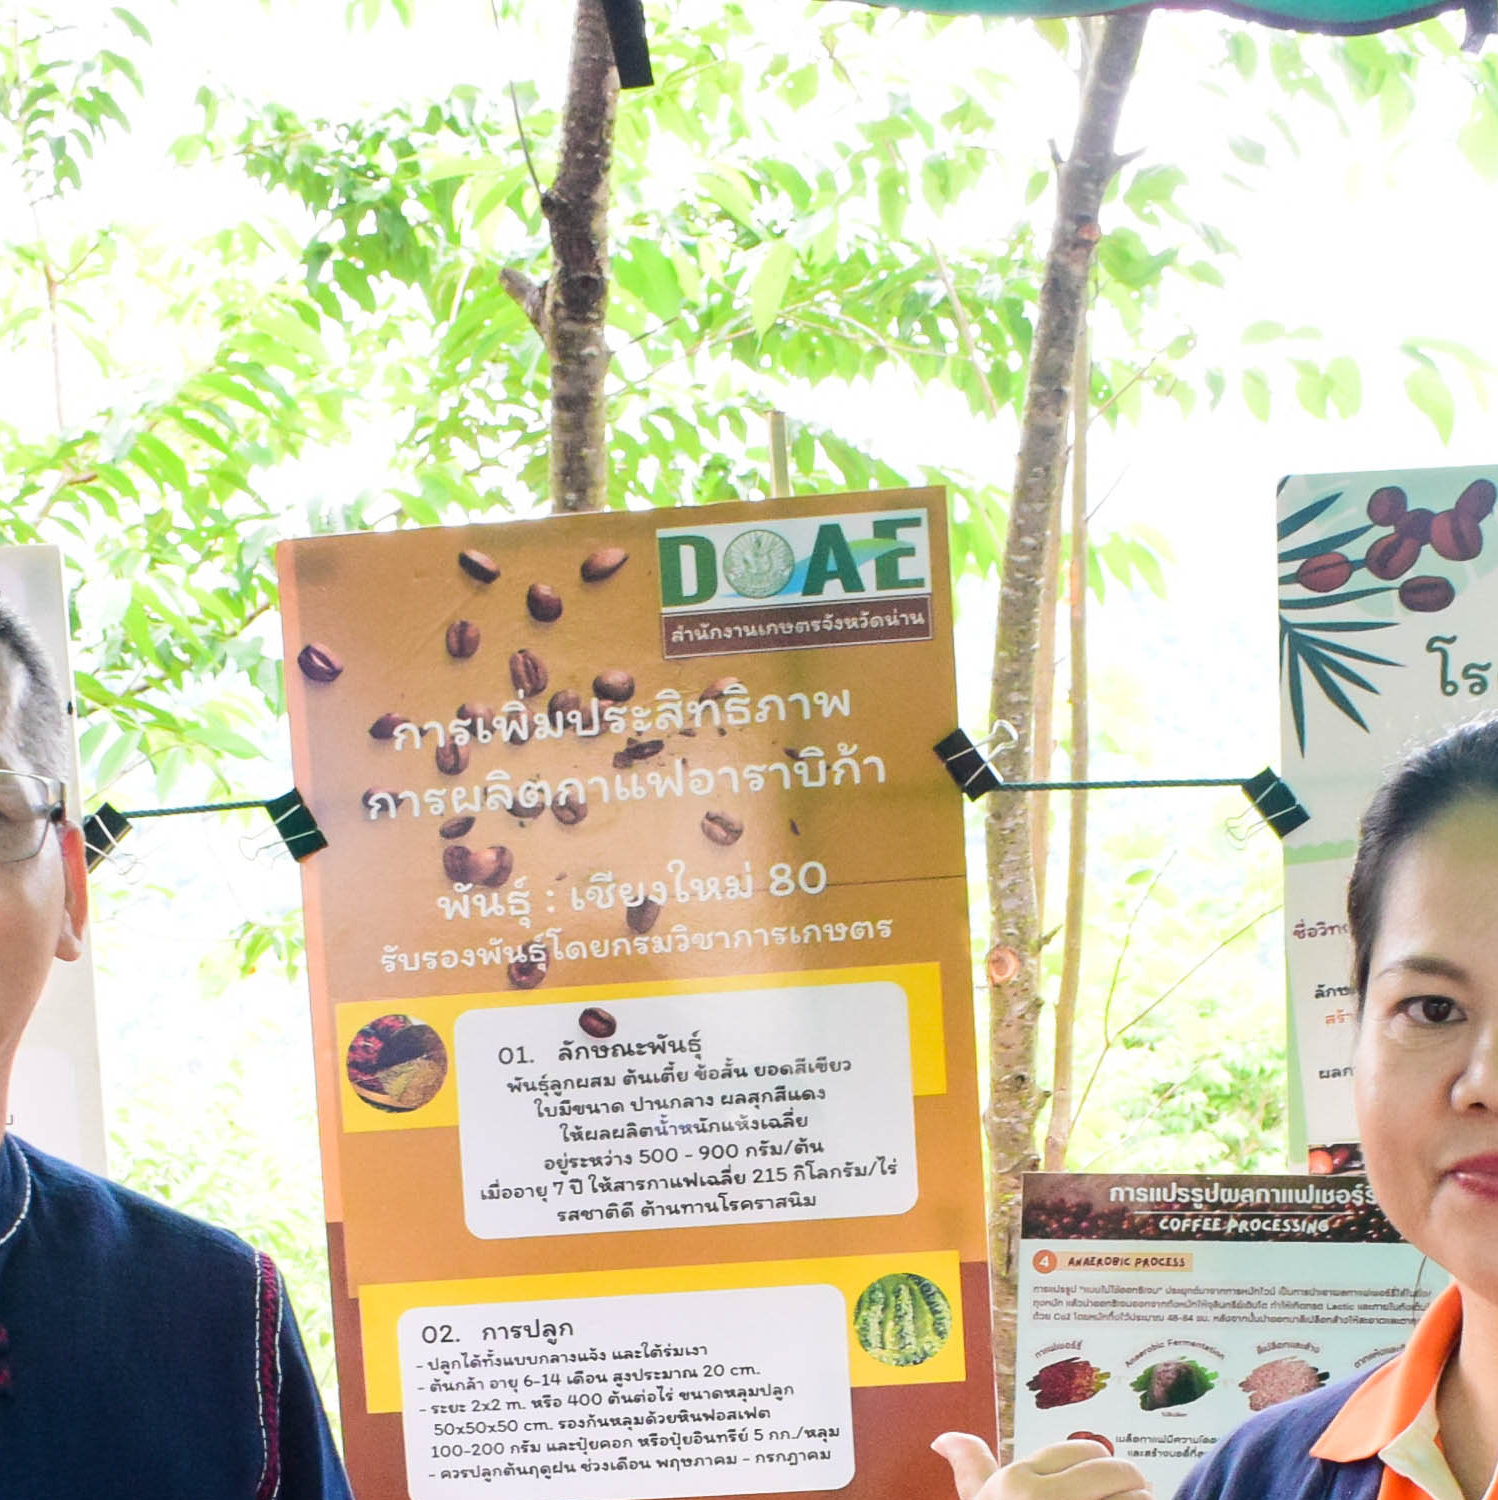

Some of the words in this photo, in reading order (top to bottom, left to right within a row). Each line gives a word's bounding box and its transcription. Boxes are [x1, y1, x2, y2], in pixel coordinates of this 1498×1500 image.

[669, 608, 927, 645] สำนักงานเกษตรจังหวัดน่าน
[391, 686, 853, 752] การเพิ่มประสิทธิภาพ
[367, 743, 888, 822] การผลิตกาแฟอาราบิก้า
[435, 873, 532, 931] พันธุ์
[569, 859, 755, 912] เชียงใหม่
[768, 861, 829, 897] 80
[380, 914, 894, 974] รับรองพันธุ์โดยกรมวิชาการเกษตร
[557, 1030, 705, 1064] ลักษณะพันธุ์
[506, 1066, 617, 1097] พันธุ์ลูกผสม
[622, 1062, 690, 1089] ต้นเตี้ย
[695, 1055, 747, 1083] ข้อสั้น
[753, 1055, 853, 1080] ยอดสีเขียว
[533, 1091, 625, 1120] ใบมีขนาด
[629, 1091, 714, 1113] ปานกลาง
[719, 1085, 827, 1112] ผลสุกสีแดง
[559, 1111, 809, 1143] ให้ผลผลิตน้ำหนักแห้งเฉลี่ย
[543, 1145, 633, 1175] อยู่ระหว่าง
[638, 1146, 680, 1165] 500
[698, 1142, 740, 1160] 900
[745, 1136, 825, 1160] กรัม/ต้น
[479, 1178, 548, 1206] เมื่ออายุ
[552, 1181, 564, 1196] 7
[568, 1175, 584, 1195] ปี
[588, 1163, 748, 1194] ให้สารกาแฟเฉลี่ย
[751, 1165, 788, 1183] 215
[556, 1199, 636, 1224] รสชาติดี
[639, 1190, 818, 1218] ต้านทานโรคราสนิม
[1158, 1216, 1222, 1233] COFFEE
[1226, 1217, 1331, 1235] PROCESSING
[1038, 1254, 1050, 1269] 4
[1067, 1254, 1132, 1269] ANAEROBIC
[1134, 1256, 1186, 1269] PROCESS
[420, 1323, 461, 1345] 02.
[481, 1317, 575, 1347] การปลูก
[427, 1345, 608, 1375] ปลูกได้ทั้งแบบกลางแจ้ง
[429, 1373, 486, 1393] ต้นกล้า
[489, 1373, 519, 1398] อายุ
[523, 1372, 562, 1388] 6-14
[566, 1363, 609, 1385] เดือน
[612, 1363, 699, 1388] สูงประมาณ
[702, 1365, 726, 1380] 20
[729, 1366, 761, 1377] cm.
[430, 1400, 467, 1416] ระยะ
[471, 1397, 503, 1412] 2x2
[506, 1399, 527, 1411] m.
[531, 1390, 563, 1410] หรือ
[567, 1392, 603, 1407] 400
[607, 1383, 674, 1406] ต้นต่อไร่
[677, 1381, 795, 1407] ขนาดหลุมปลูก
[431, 1440, 506, 1459] 100-200
[509, 1436, 542, 1454] กรัม
[753, 1427, 764, 1440] 5
[432, 1420, 520, 1437] 50x50x50
[523, 1419, 554, 1432] cm.
[440, 1458, 577, 1483] ควรปลูกต้นฤดูฝน
[580, 1451, 652, 1473] ช่วงเดือน
[655, 1451, 738, 1475] พฤษภาคม
[754, 1447, 832, 1468] กรกฎาคม
